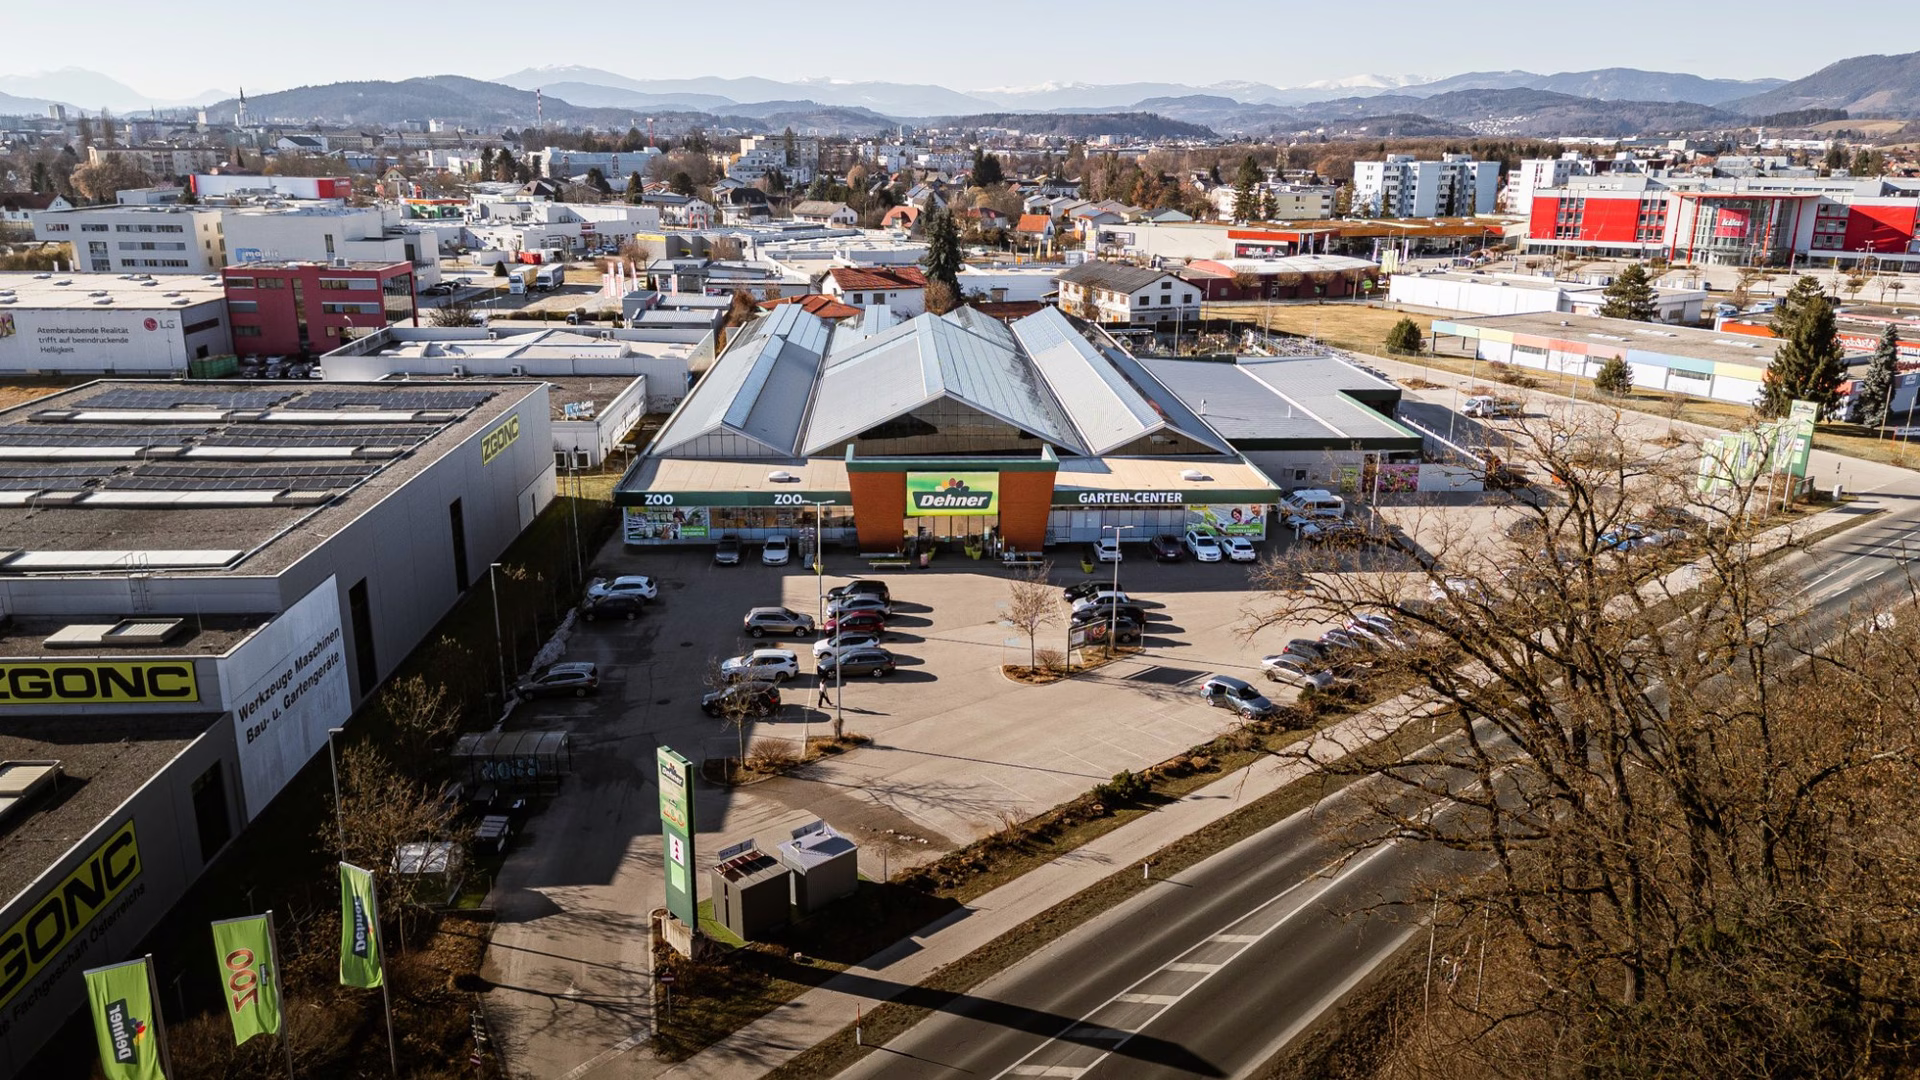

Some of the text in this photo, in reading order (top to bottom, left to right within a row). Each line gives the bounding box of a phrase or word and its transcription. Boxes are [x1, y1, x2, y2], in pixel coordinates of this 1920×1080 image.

[160, 320, 175, 329] LG
[40, 346, 75, 355] Helligkeit
[483, 417, 519, 460] ZGONC
[644, 494, 674, 505] ZOO
[774, 494, 803, 505] ZOO
[920, 494, 988, 507] Dehner
[1078, 492, 1183, 503] GARTEN-CENTER
[238, 627, 340, 722] Werkzeuge Maschinen
[0, 666, 191, 699] GONC
[246, 651, 339, 744] Bau- u. Gartengeräte
[13, 883, 145, 1021] Fachgeschäft Österreichs
